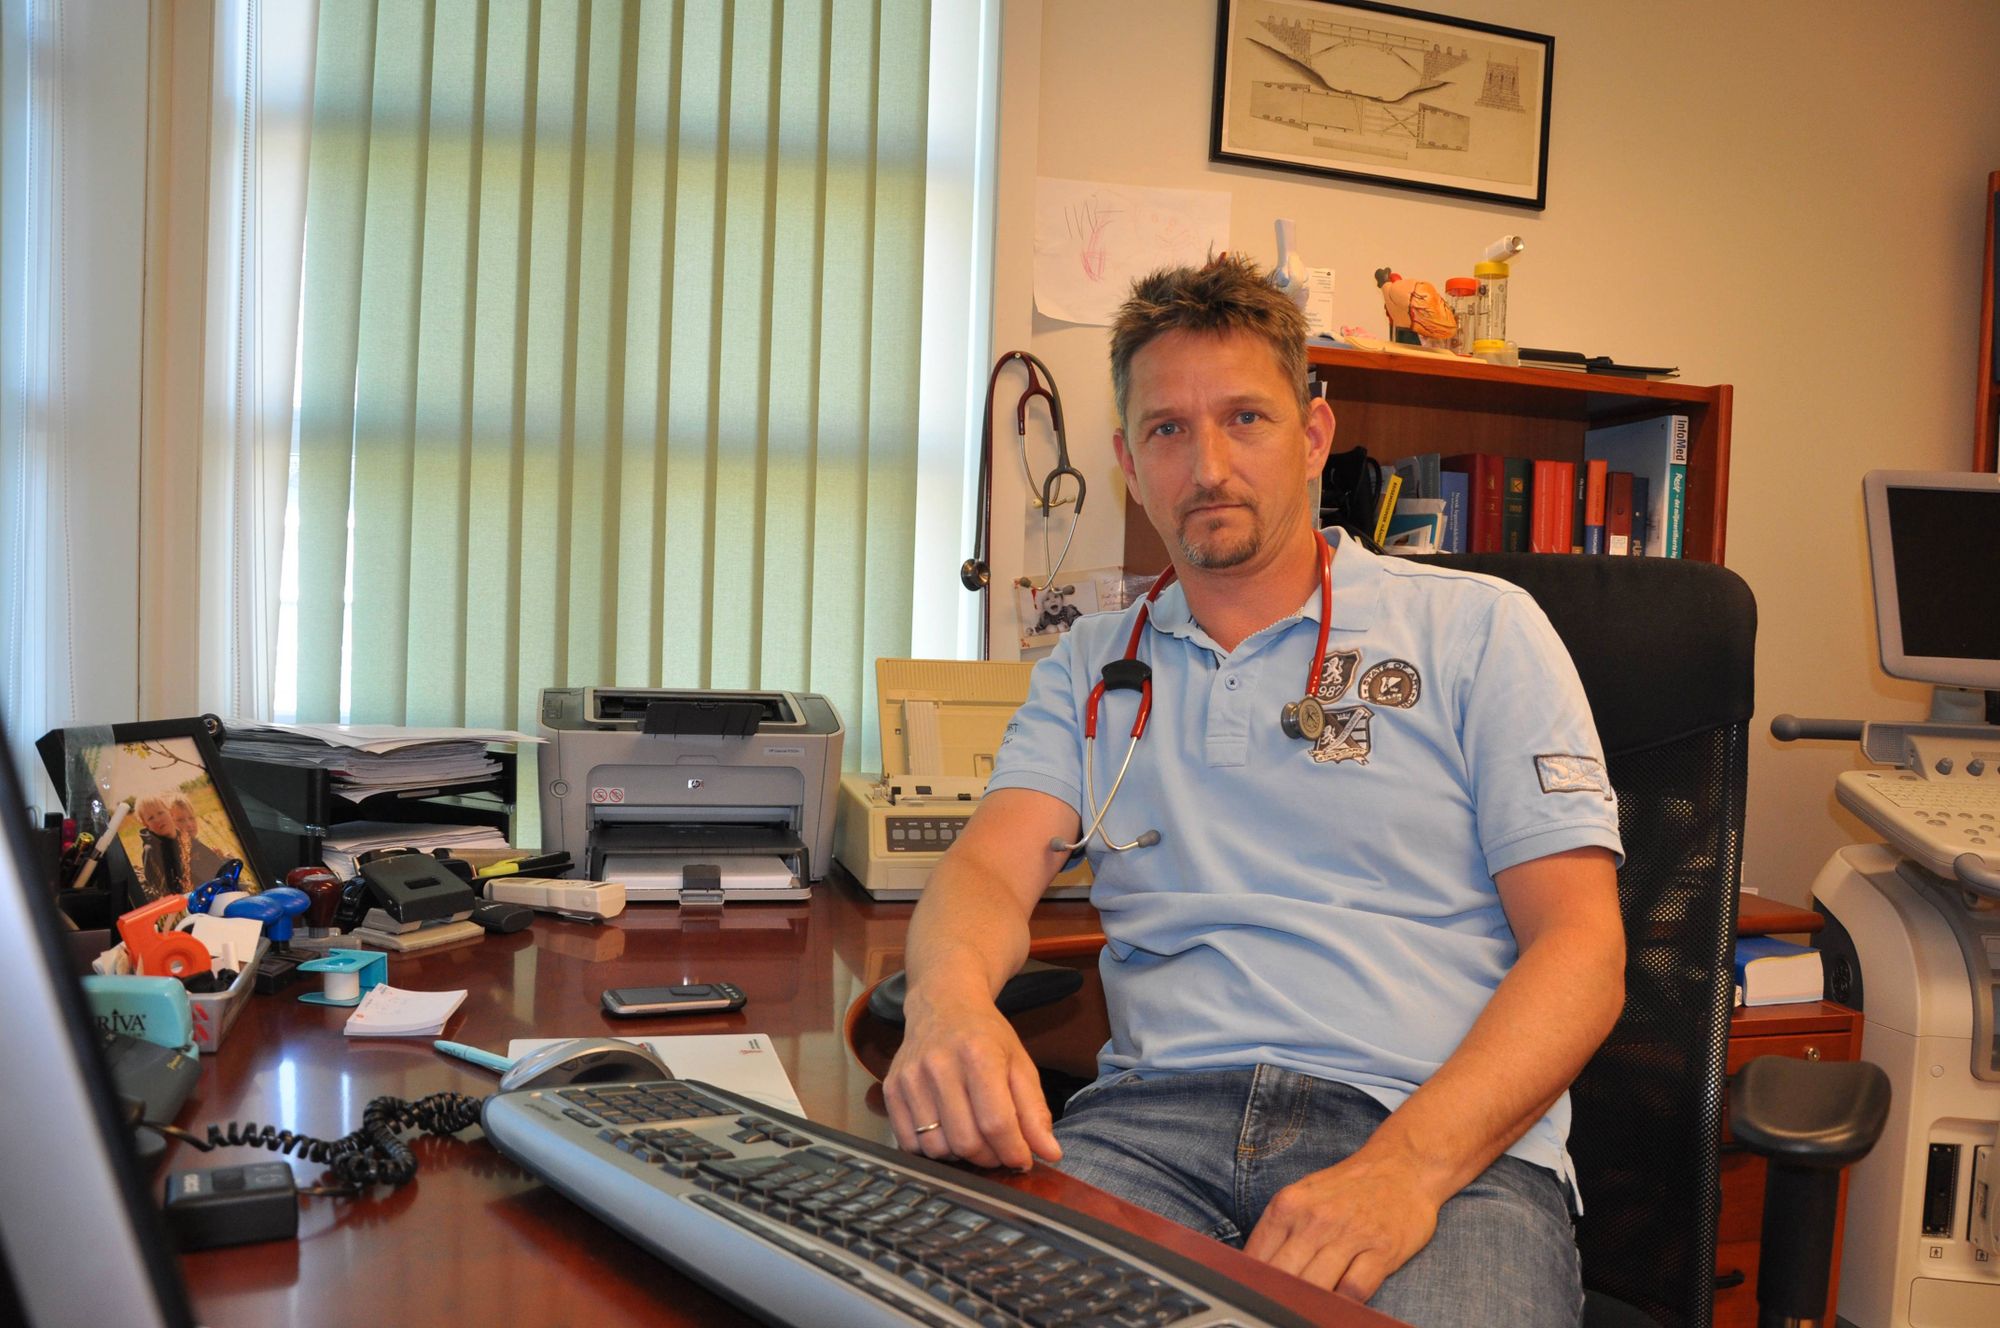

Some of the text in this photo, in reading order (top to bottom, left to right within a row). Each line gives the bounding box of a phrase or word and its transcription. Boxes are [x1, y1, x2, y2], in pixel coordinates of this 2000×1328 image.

[1675, 420, 1687, 461] InfoMed
[1363, 663, 1389, 686] STATE
[1393, 662, 1408, 671] OF
[1318, 685, 1343, 698] 987
[97, 1009, 146, 1031] RIVA
